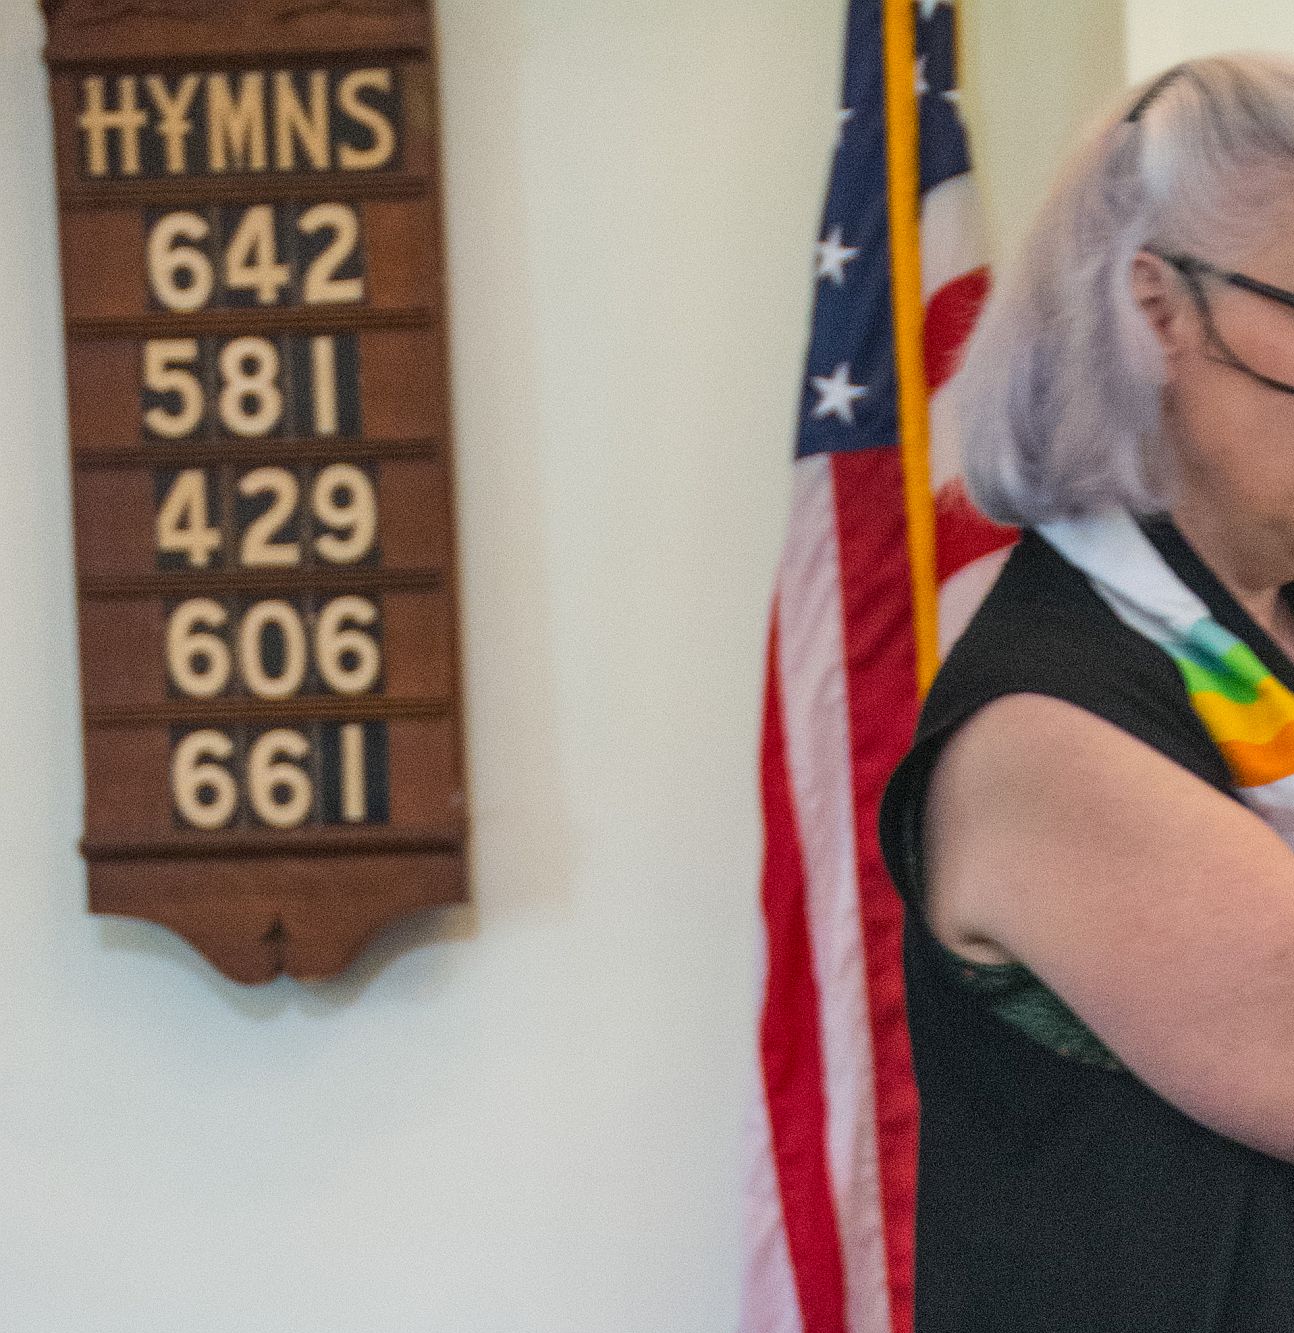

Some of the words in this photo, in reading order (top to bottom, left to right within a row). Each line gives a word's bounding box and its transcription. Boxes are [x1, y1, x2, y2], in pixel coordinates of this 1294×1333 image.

[80, 68, 395, 174] HYMNS
[147, 204, 364, 312] 642
[144, 336, 337, 437] 581
[156, 464, 378, 567] 429
[166, 597, 380, 697] 606
[171, 726, 365, 828] 661
